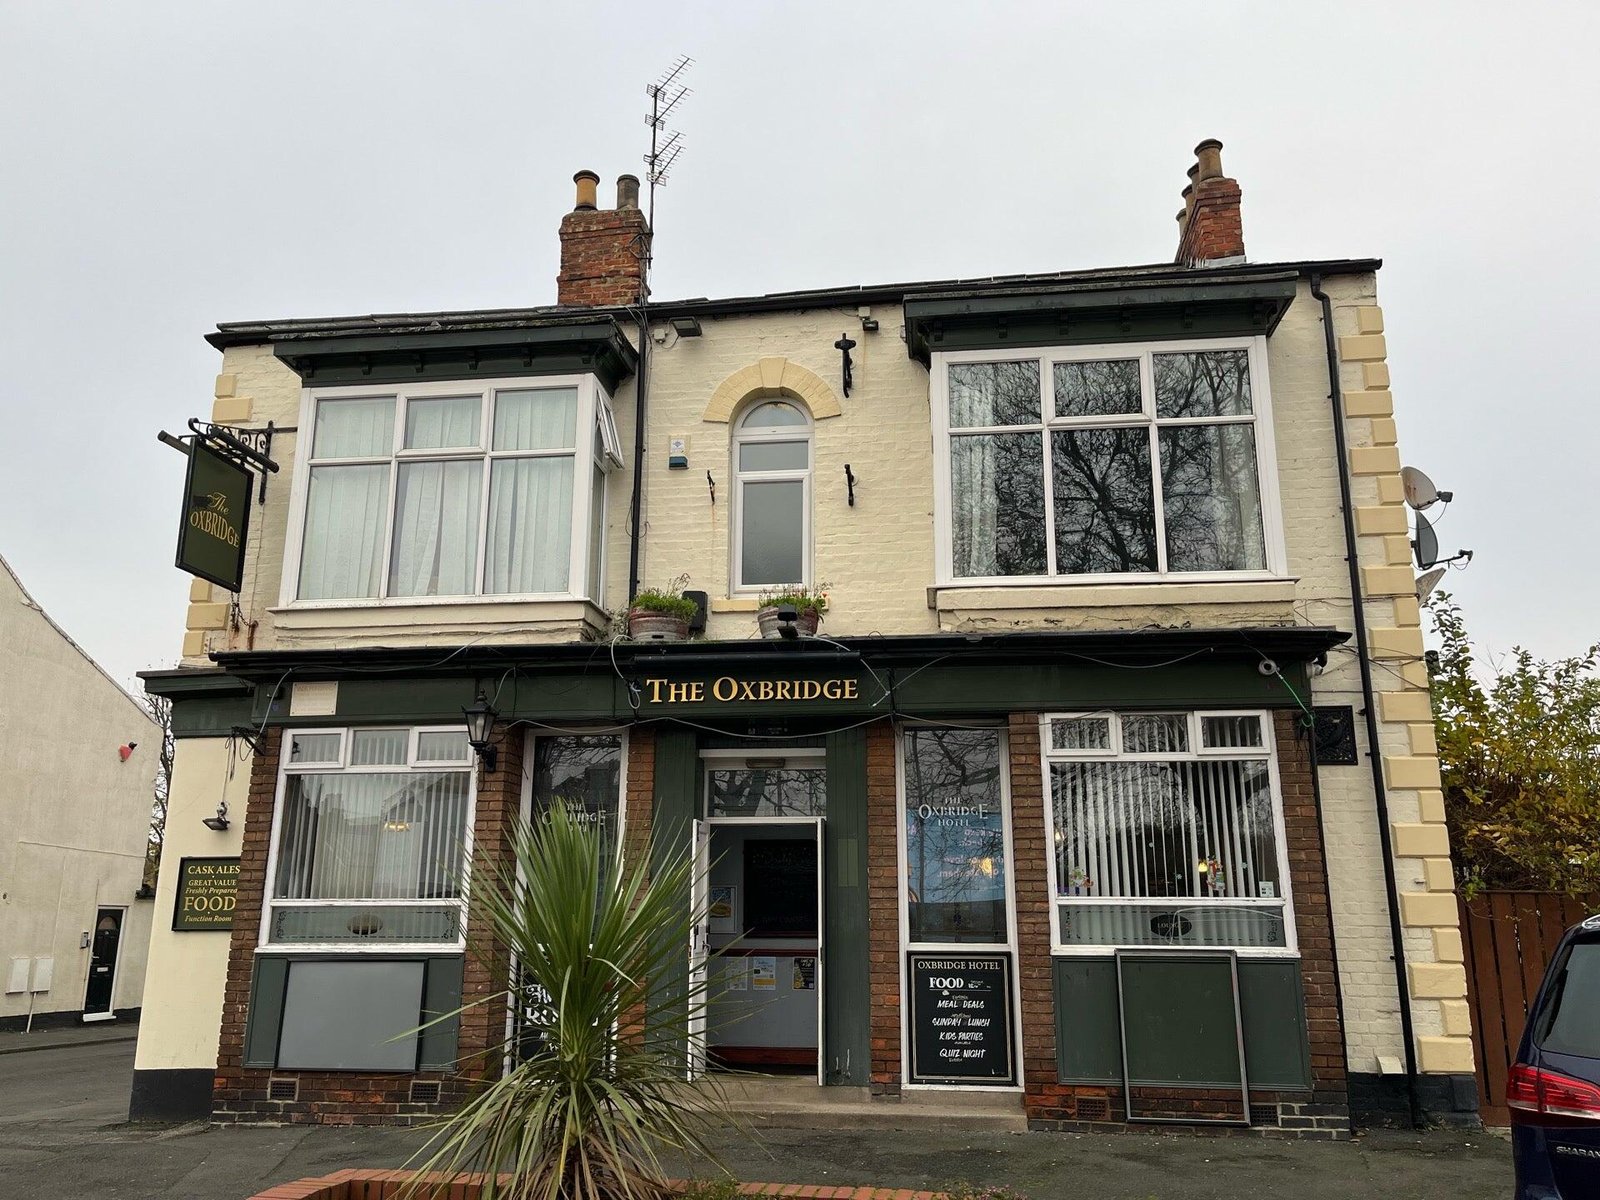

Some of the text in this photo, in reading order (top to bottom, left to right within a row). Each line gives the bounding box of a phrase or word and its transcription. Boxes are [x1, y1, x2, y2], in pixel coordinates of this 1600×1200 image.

[207, 491, 230, 515] The
[190, 510, 240, 548] OXBRIDGE
[646, 676, 859, 703] THE OXBRIDGE
[918, 803, 988, 819] OXBRIDGE
[188, 865, 241, 874] CASK ALES
[185, 887, 208, 895] Freshly
[183, 896, 236, 912] FOOD
[918, 961, 1000, 970] OXBRIDGE HOTEL
[929, 977, 964, 989] FOOD
[937, 1000, 985, 1009] MEAL DEALS
[932, 1017, 990, 1027] SUNDAY LUNCH
[939, 1031, 984, 1041] KIDS PARTIES
[939, 1048, 986, 1059] QUIZ NIGHT
